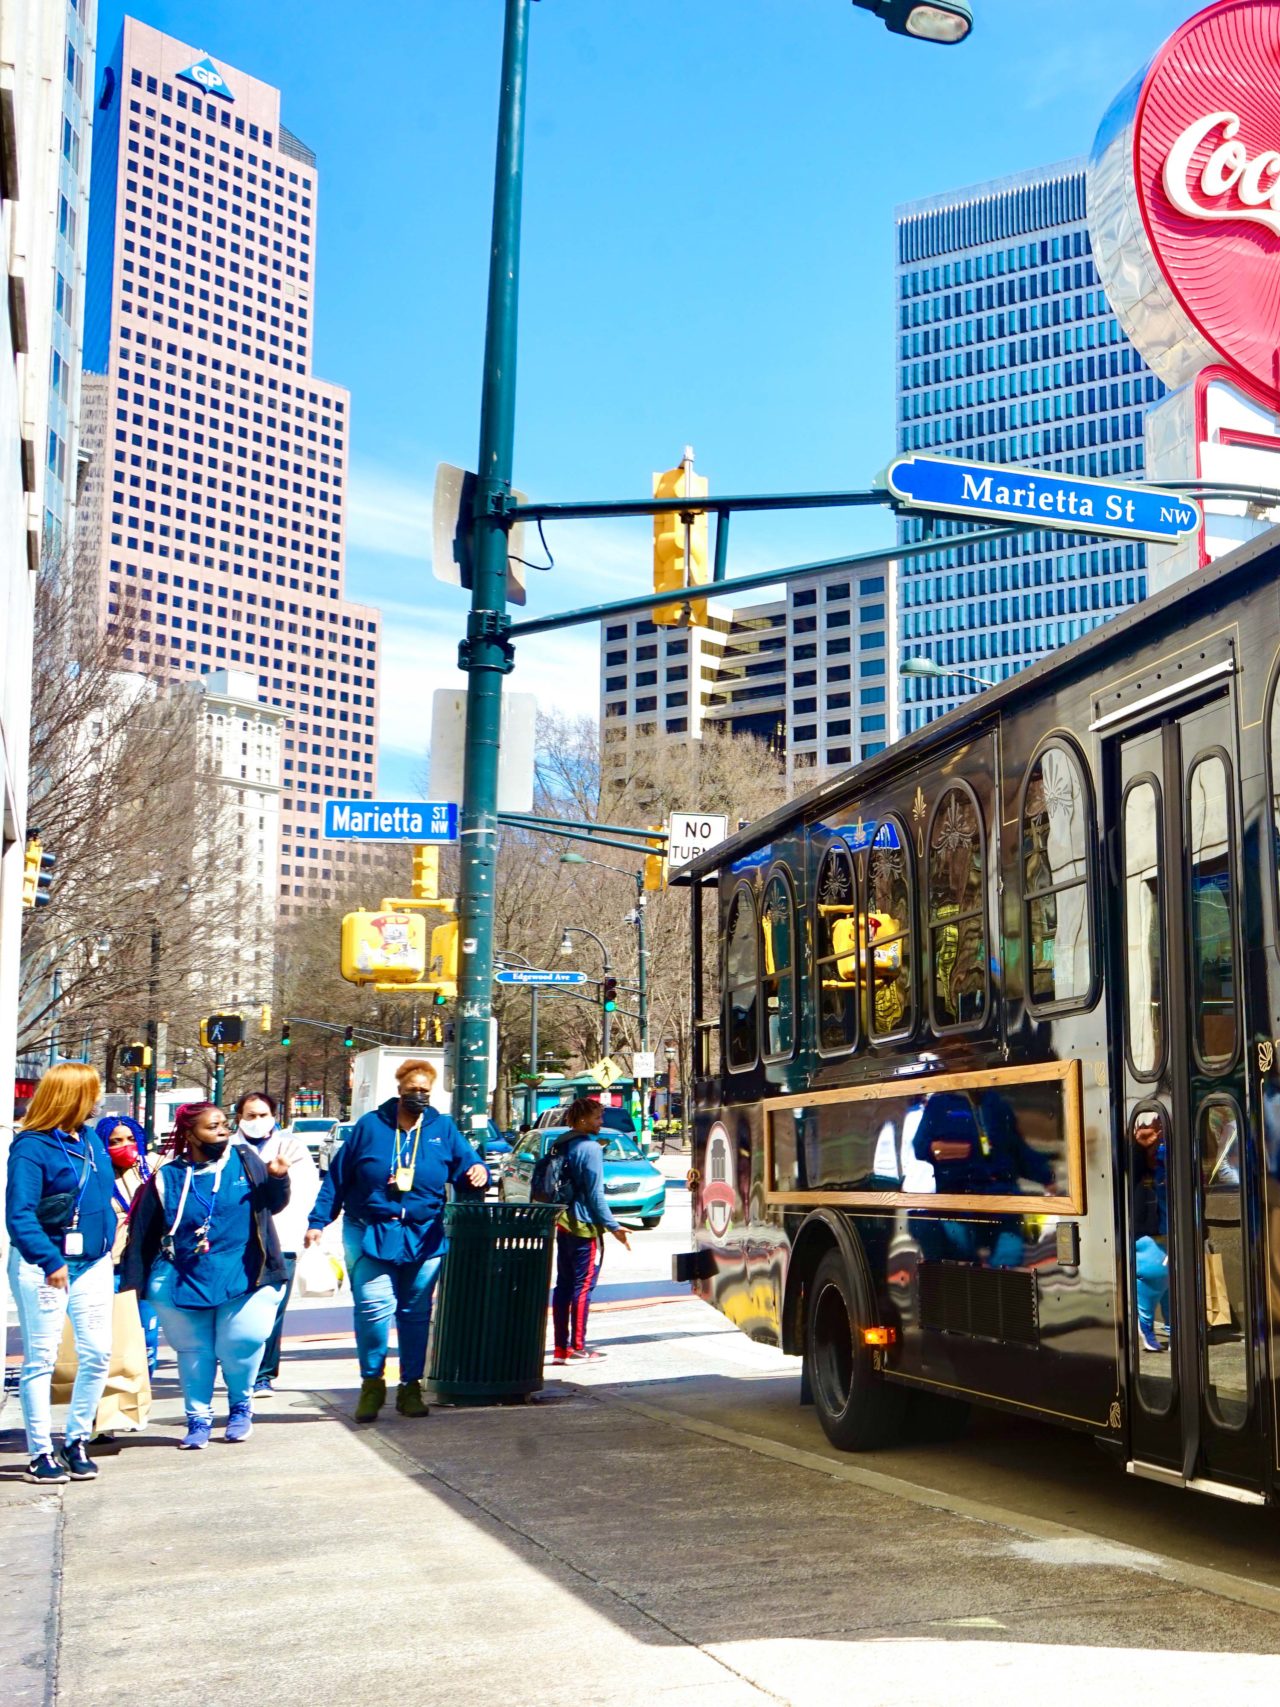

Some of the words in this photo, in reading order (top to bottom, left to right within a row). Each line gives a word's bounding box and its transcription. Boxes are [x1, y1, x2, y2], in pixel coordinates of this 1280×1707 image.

[191, 66, 223, 88] GP
[961, 473, 1095, 517] Marietta
[1105, 494, 1136, 522] St
[1159, 507, 1192, 526] NW
[332, 805, 423, 833] Marietta
[431, 806, 448, 820] ST
[430, 820, 449, 834] NW
[685, 821, 712, 839] NO
[672, 845, 707, 860] TUR
[555, 973, 570, 981] Ave
